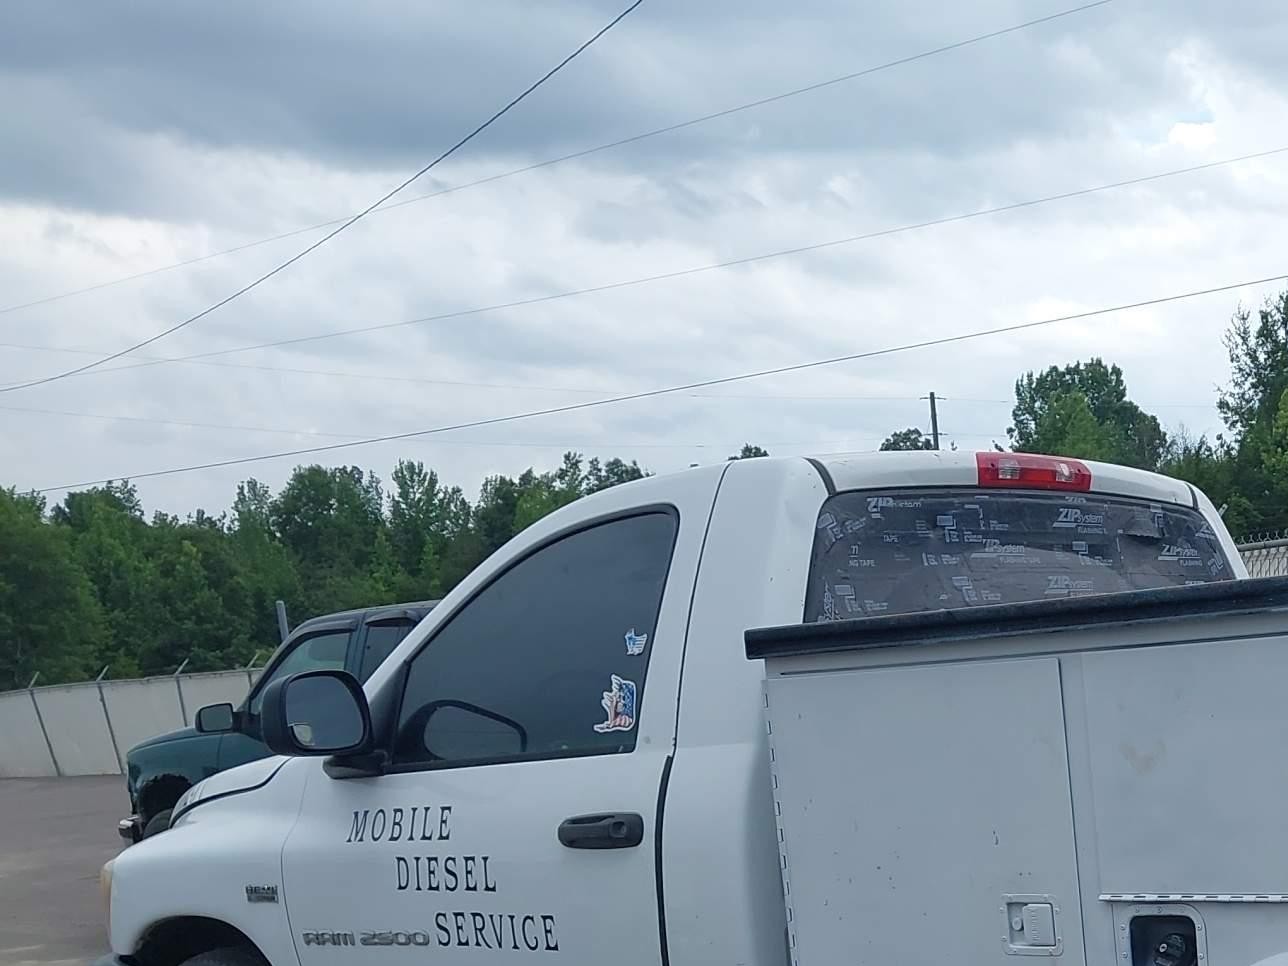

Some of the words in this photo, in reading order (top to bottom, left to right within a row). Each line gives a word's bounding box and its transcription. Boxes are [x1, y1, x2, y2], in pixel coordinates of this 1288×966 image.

[345, 806, 453, 843] MOBILE
[395, 855, 497, 892] DIESEL
[302, 931, 356, 946] RAM
[360, 931, 430, 946] 2500
[434, 912, 559, 951] SERVICE
